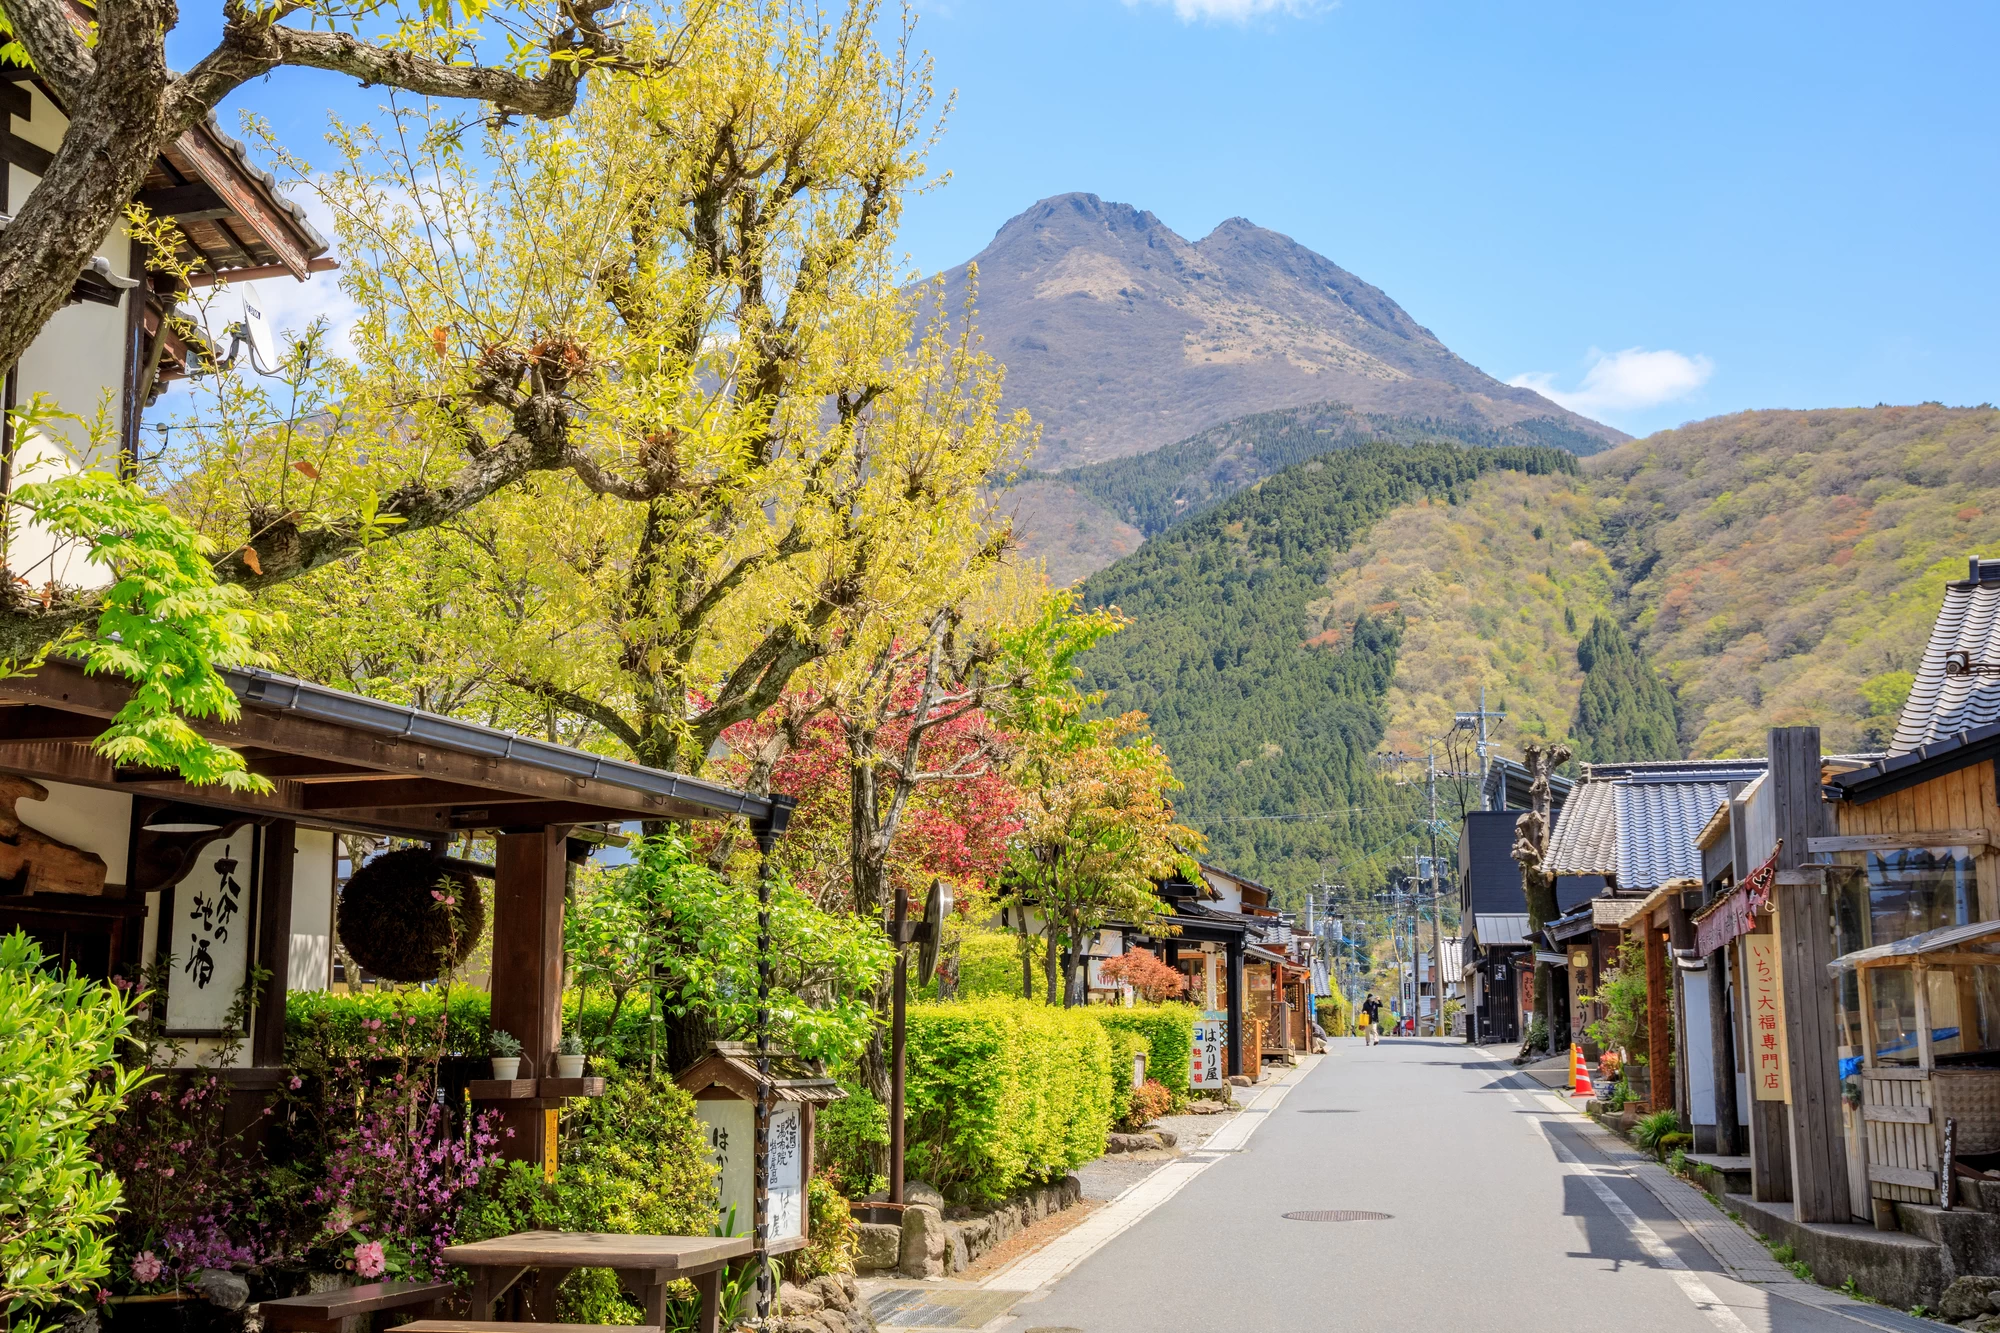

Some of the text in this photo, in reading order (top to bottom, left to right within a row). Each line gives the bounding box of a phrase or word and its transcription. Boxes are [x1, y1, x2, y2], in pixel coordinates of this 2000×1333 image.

[213, 844, 242, 944] 大分の
[184, 890, 215, 990] 地酒
[1204, 1028, 1219, 1082] はかり屋
[1753, 945, 1780, 1089] いちご大福専門店
[1192, 1048, 1203, 1083] 駐車場
[712, 1127, 729, 1214] はかり
[776, 1122, 788, 1166] 湯布院
